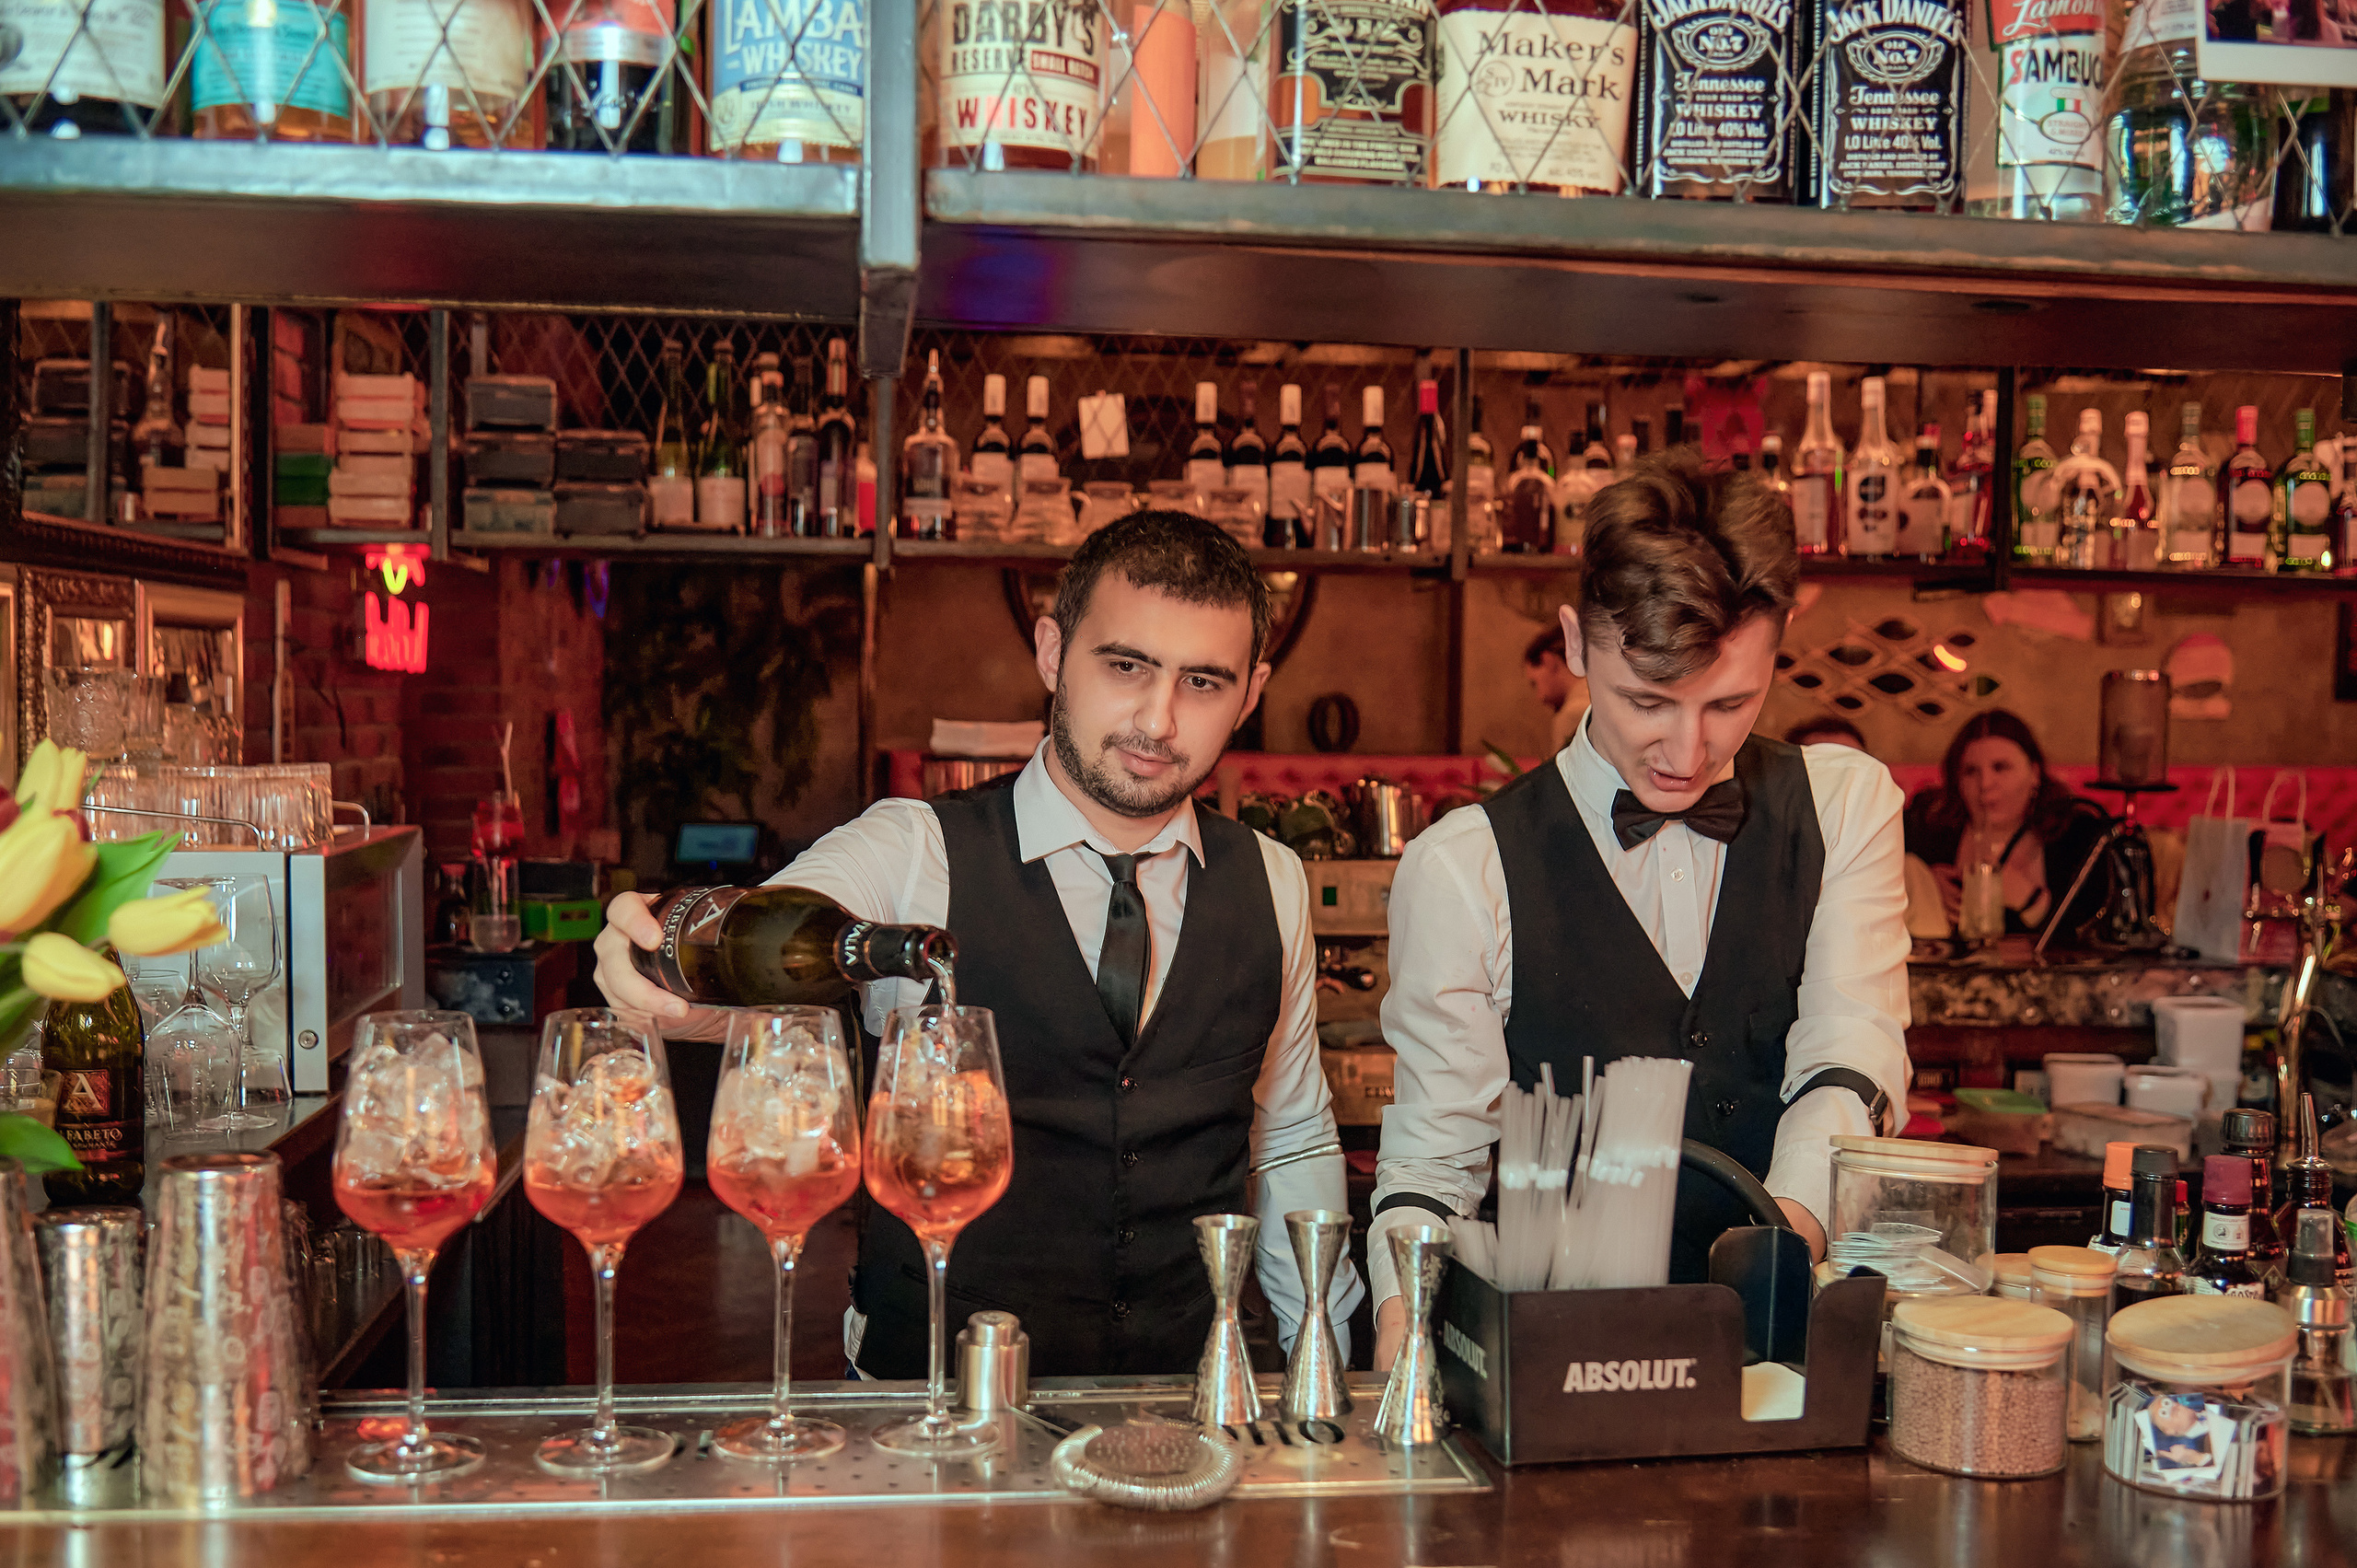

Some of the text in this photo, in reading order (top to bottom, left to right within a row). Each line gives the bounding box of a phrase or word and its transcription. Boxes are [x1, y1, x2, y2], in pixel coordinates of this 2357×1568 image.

[953, 1, 1096, 55] DARBY'S
[1826, 0, 1965, 44] JACK DANIEL'S
[1882, 40, 1907, 50] Old
[1519, 67, 1620, 101] Mark
[1674, 72, 1767, 93] Tennessee
[1498, 110, 1601, 129] WHISKY
[1676, 103, 1765, 119] WHISKEY
[1717, 122, 1746, 138] 40%
[1850, 117, 1939, 132] WHISKEY
[1921, 135, 1944, 150] Vol.
[65, 1073, 103, 1111] A
[60, 1128, 123, 1143] FABETO
[1562, 1357, 1698, 1393] ABSOLUT.
